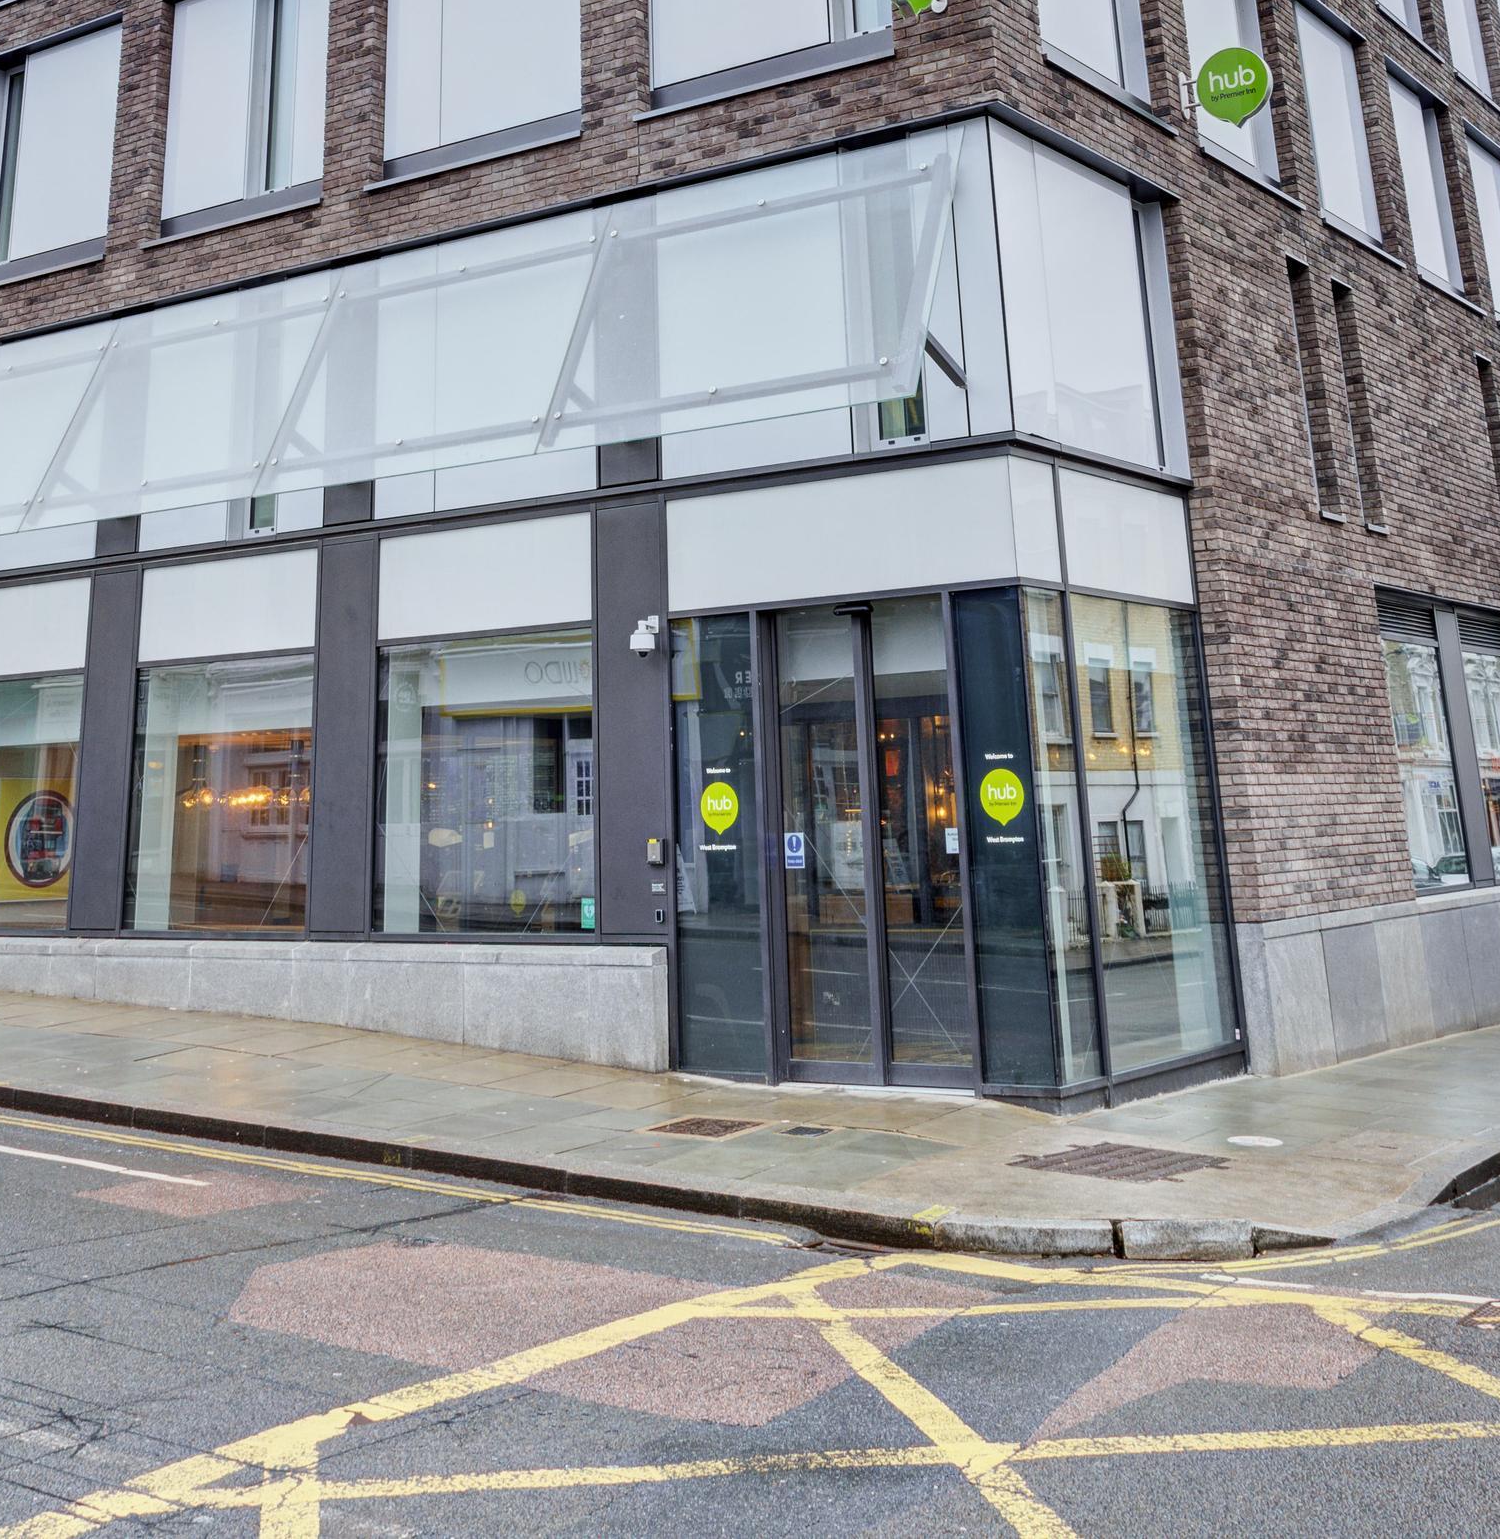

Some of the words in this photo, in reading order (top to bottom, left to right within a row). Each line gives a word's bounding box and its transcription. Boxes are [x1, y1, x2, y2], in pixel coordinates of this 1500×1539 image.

[1208, 64, 1256, 93] hub
[1220, 89, 1245, 99] Premier
[987, 783, 1017, 800] hub
[707, 795, 732, 811] hub
